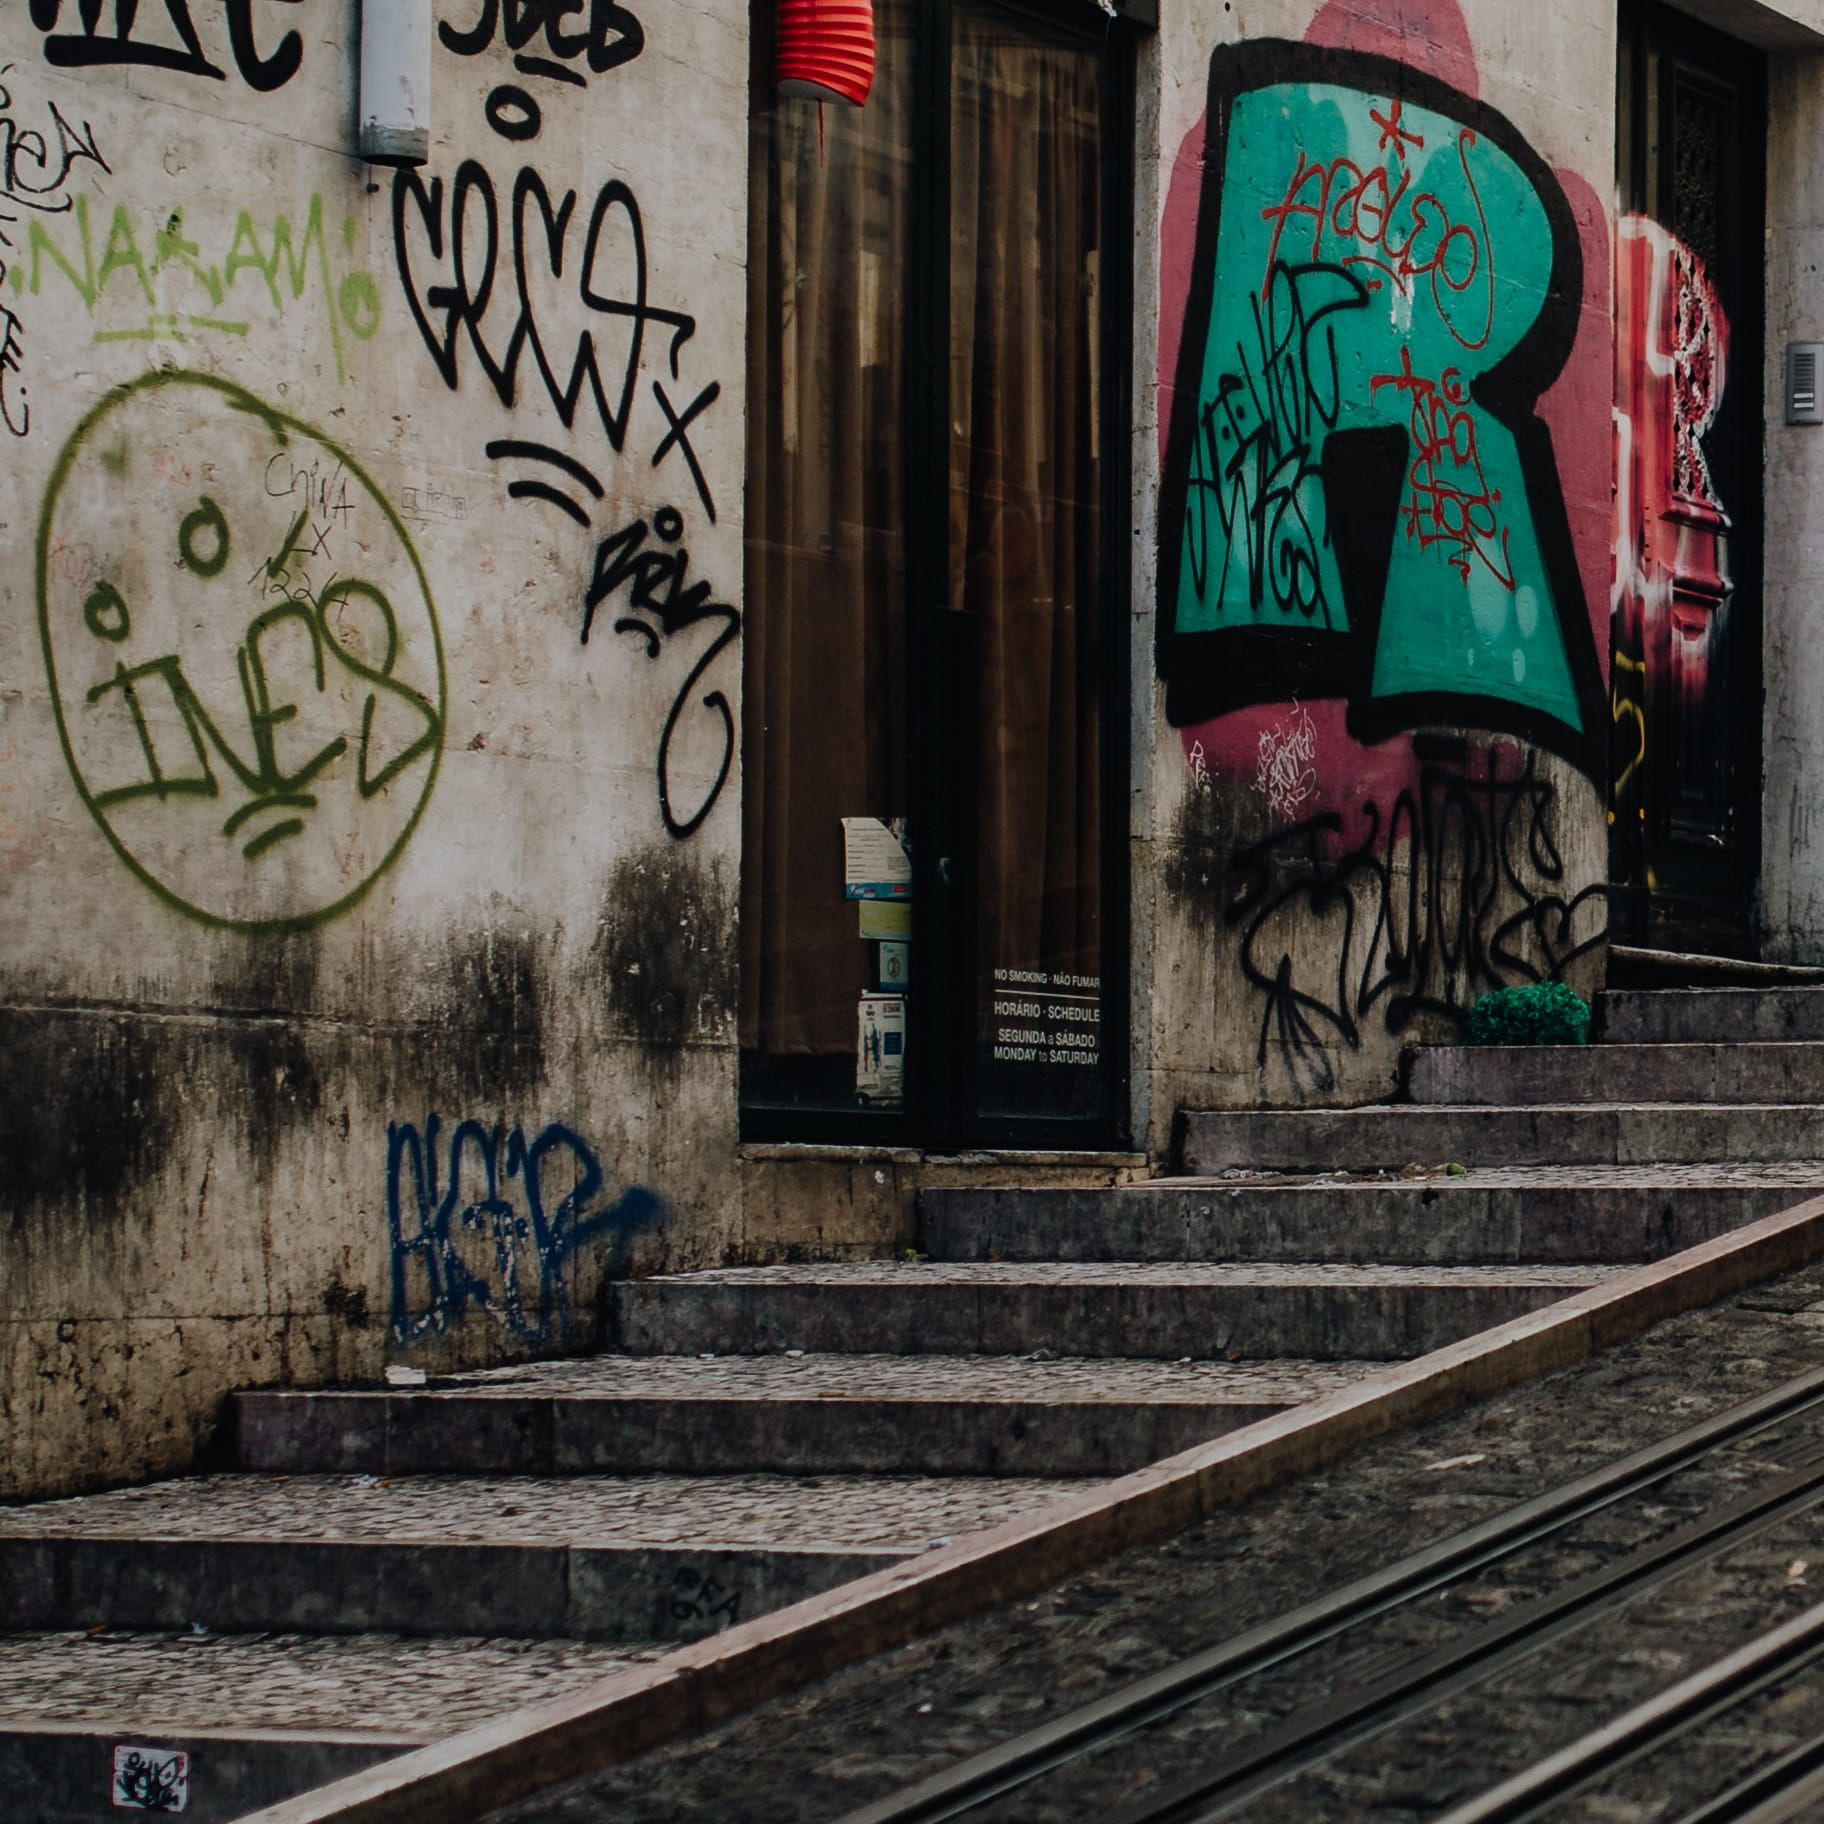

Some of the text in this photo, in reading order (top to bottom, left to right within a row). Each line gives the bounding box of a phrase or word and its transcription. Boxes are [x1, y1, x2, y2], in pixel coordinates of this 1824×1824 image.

[994, 968, 1100, 988] NO SMOKING NÃO FUMAR
[994, 999, 1100, 1023] HORÁRIO SCHEDULE
[998, 1028, 1046, 1045] SEGUNDA
[1055, 1028, 1096, 1048] SÁBADO
[994, 1046, 1037, 1061] MONDAY
[1049, 1049, 1100, 1065] SATURDAY
